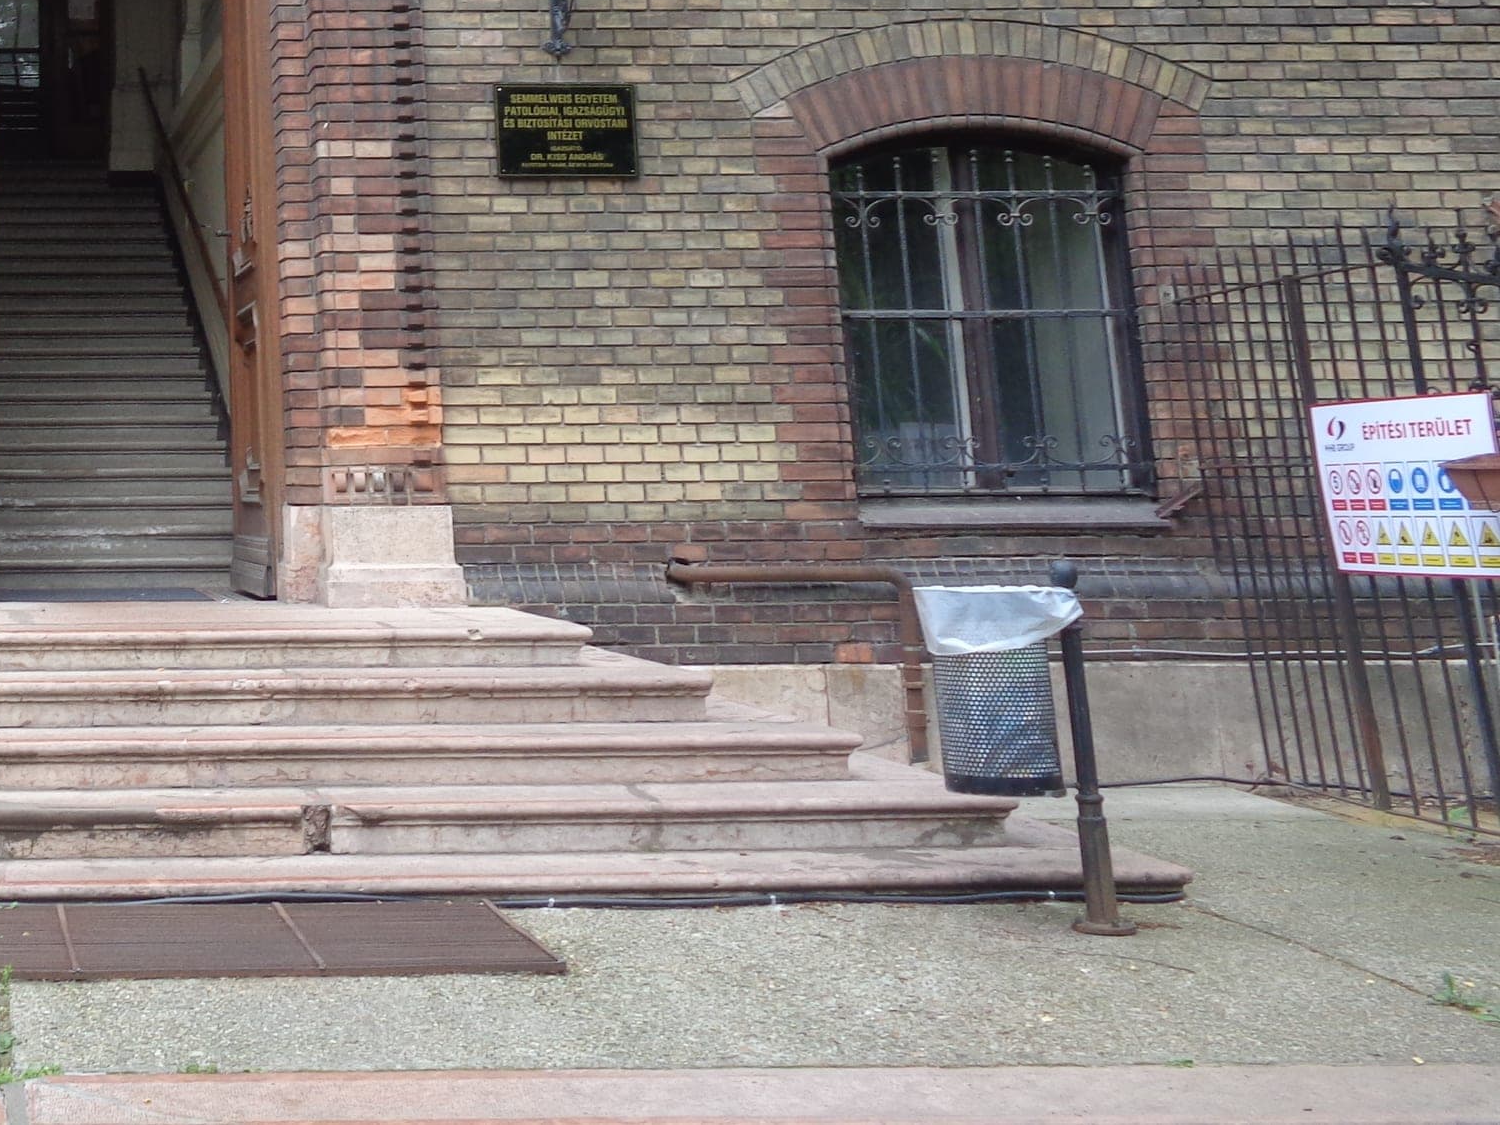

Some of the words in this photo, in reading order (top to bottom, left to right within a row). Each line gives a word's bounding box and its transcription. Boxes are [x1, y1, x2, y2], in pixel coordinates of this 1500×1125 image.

[510, 94, 572, 104] SEMMELWEIS
[574, 94, 618, 104] EGYETEM
[504, 104, 561, 116] PATOLÓGIAI,
[563, 104, 625, 116] IGAZSÁGÜGYI
[503, 116, 515, 128] ÉS
[517, 116, 573, 128] BIZTOSÍTÁSI
[575, 118, 628, 128] ORVOSTANI
[547, 129, 583, 140] INTÉZET
[530, 153, 546, 161] DR.
[1362, 420, 1407, 440] ÉPÍTÉSI
[1409, 417, 1472, 438] TERÜLET
